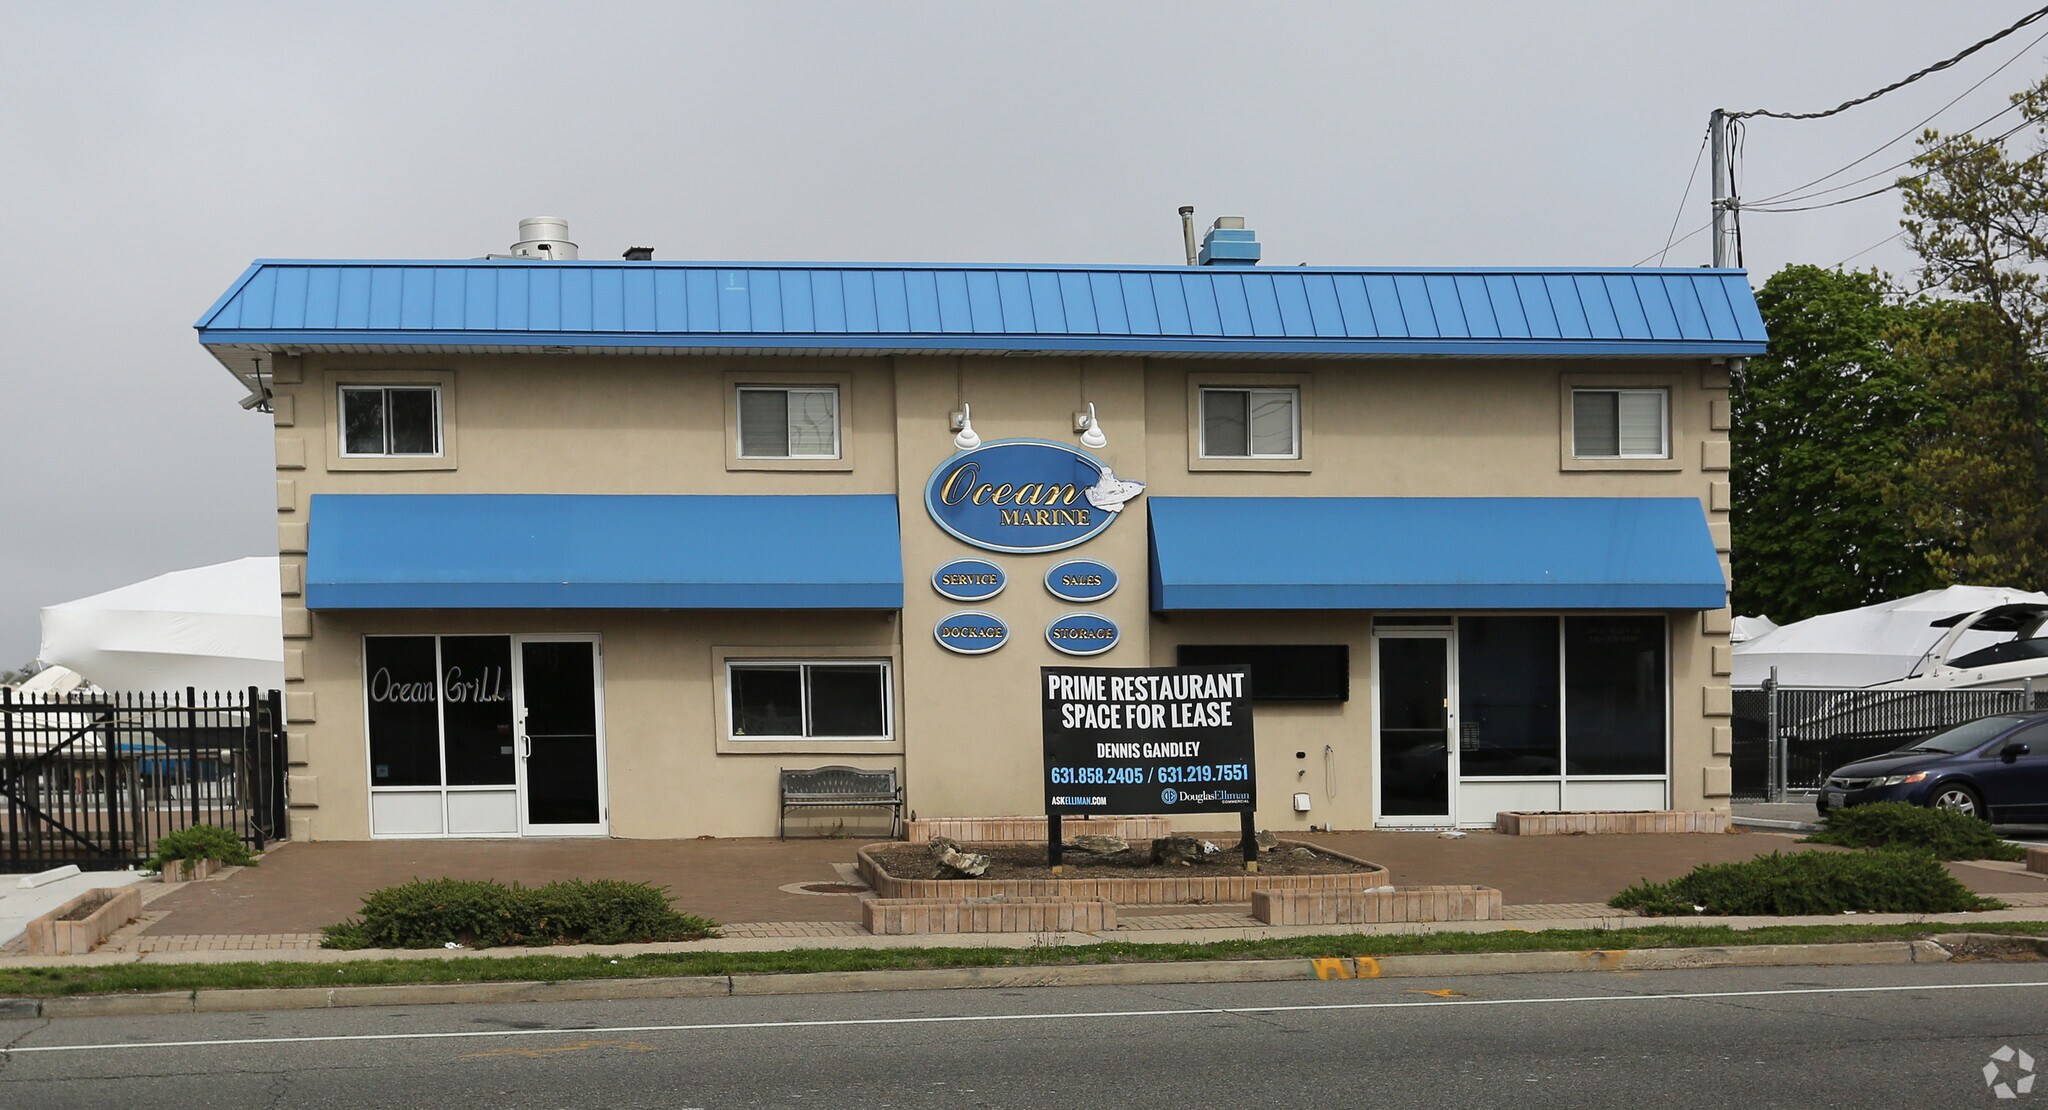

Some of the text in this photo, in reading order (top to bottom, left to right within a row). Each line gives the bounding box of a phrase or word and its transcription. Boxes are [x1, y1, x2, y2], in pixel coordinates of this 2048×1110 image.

[940, 462, 1091, 506] Ocean
[1000, 508, 1091, 527] MARINE
[942, 574, 997, 585] SERVICE
[1062, 575, 1101, 586] SALES
[941, 627, 1003, 639] DOCKAGE
[1053, 628, 1113, 640] STORAGE
[371, 667, 436, 702] Ocean
[1048, 673, 1244, 701] PRIME RESTAURANT
[1061, 702, 1232, 729] SPACE FOR LEASE
[1097, 741, 1200, 759] DENNIS GANDLEY
[1051, 767, 1144, 784] 631.858.2405
[1158, 764, 1249, 783] 631.219.7551
[1051, 796, 1107, 806] ASKELLIMAN.COM
